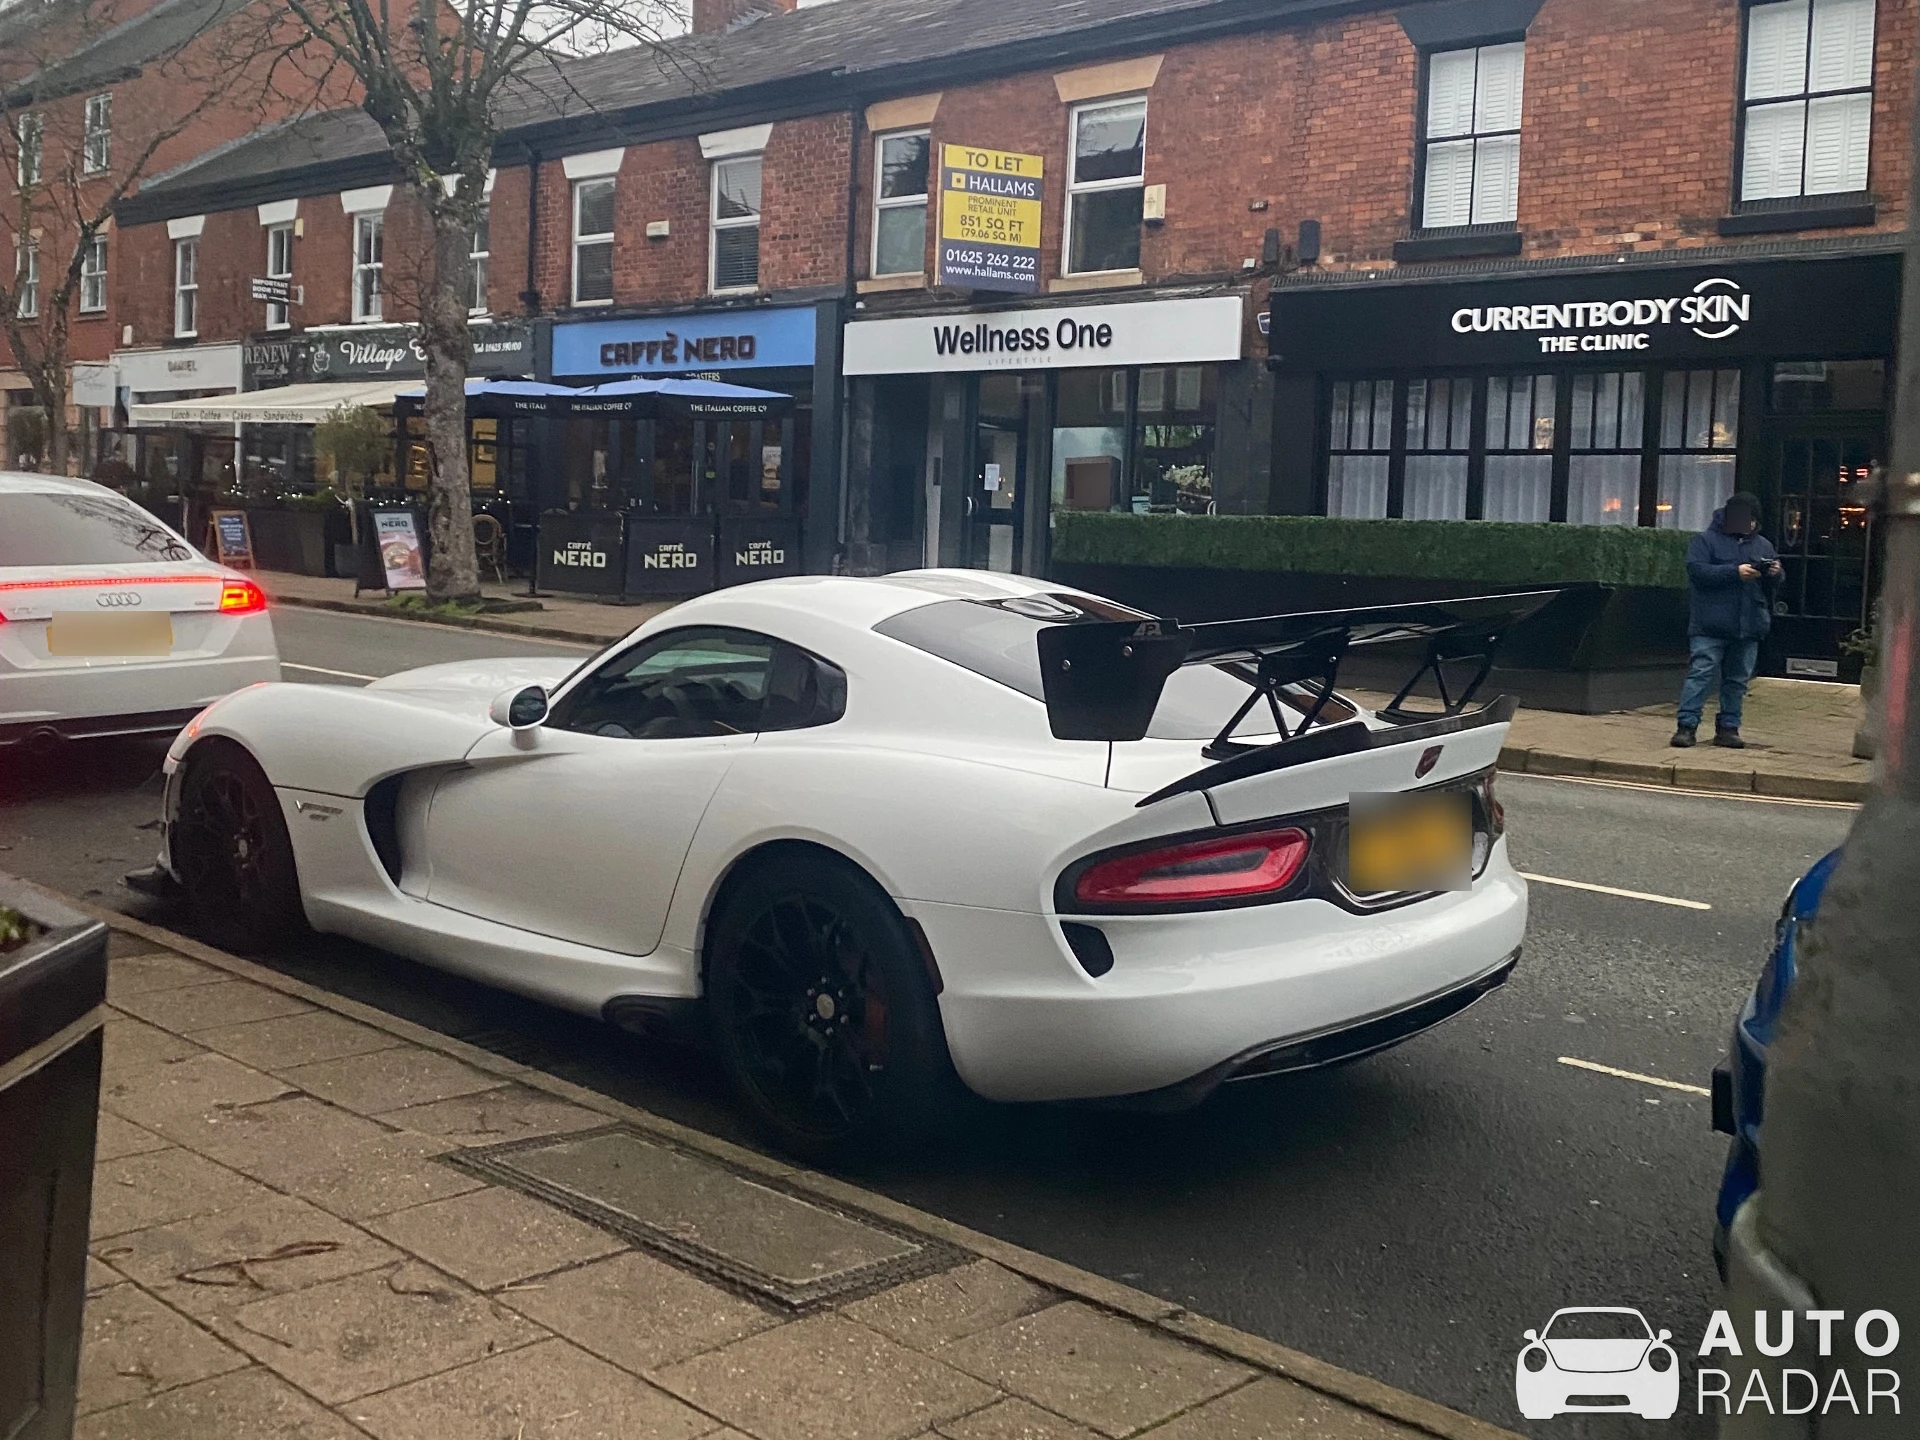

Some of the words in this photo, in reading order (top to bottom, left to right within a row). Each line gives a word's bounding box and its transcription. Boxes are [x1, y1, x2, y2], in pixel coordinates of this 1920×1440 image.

[965, 151, 989, 168] TO
[995, 155, 1023, 172] LET
[969, 175, 1035, 196] HALLAMS
[968, 195, 1018, 208] PROMINENT
[968, 204, 994, 214] RETAIL
[997, 207, 1017, 216] UNIT
[960, 214, 981, 227] 851
[986, 217, 1004, 230] SQ
[1009, 220, 1024, 232] FT
[961, 227, 989, 239] (79.06
[992, 230, 1006, 242] SQ
[1009, 232, 1022, 243] M)
[946, 248, 983, 264] 01625
[986, 252, 1009, 267] 262
[1012, 255, 1035, 270] 222
[945, 264, 1035, 281] www.hallams.com
[1451, 297, 1680, 333] CURRENTBODY
[1680, 293, 1750, 324] SKIN
[933, 323, 1050, 355] Wellness
[1056, 317, 1112, 349] One
[1539, 336, 1578, 353] THE
[1580, 333, 1650, 351] CLINIC
[244, 344, 292, 364] RENEW
[340, 341, 406, 370] Village
[600, 331, 679, 367] CAFFÈ
[684, 335, 757, 363] NERO
[988, 356, 1052, 366] LIFESTYLE
[529, 402, 547, 410] ITALI
[582, 403, 602, 411] ITALIAN
[603, 402, 623, 410] COFFEE
[690, 403, 704, 412] THE
[705, 404, 732, 412] ITALIAN
[732, 404, 757, 413] COFFEE
[171, 409, 190, 419] Lunch
[200, 409, 221, 420] Coffee
[232, 410, 251, 421] Cakes
[263, 410, 304, 421] Sandwiches
[381, 520, 408, 528] NERO
[567, 541, 591, 550] CAFFÈ
[659, 543, 684, 551] CAFFÈ
[748, 540, 772, 549] CAFFÈ
[553, 550, 606, 568] NERO
[644, 552, 697, 569] NERO
[735, 549, 784, 566] NERO
